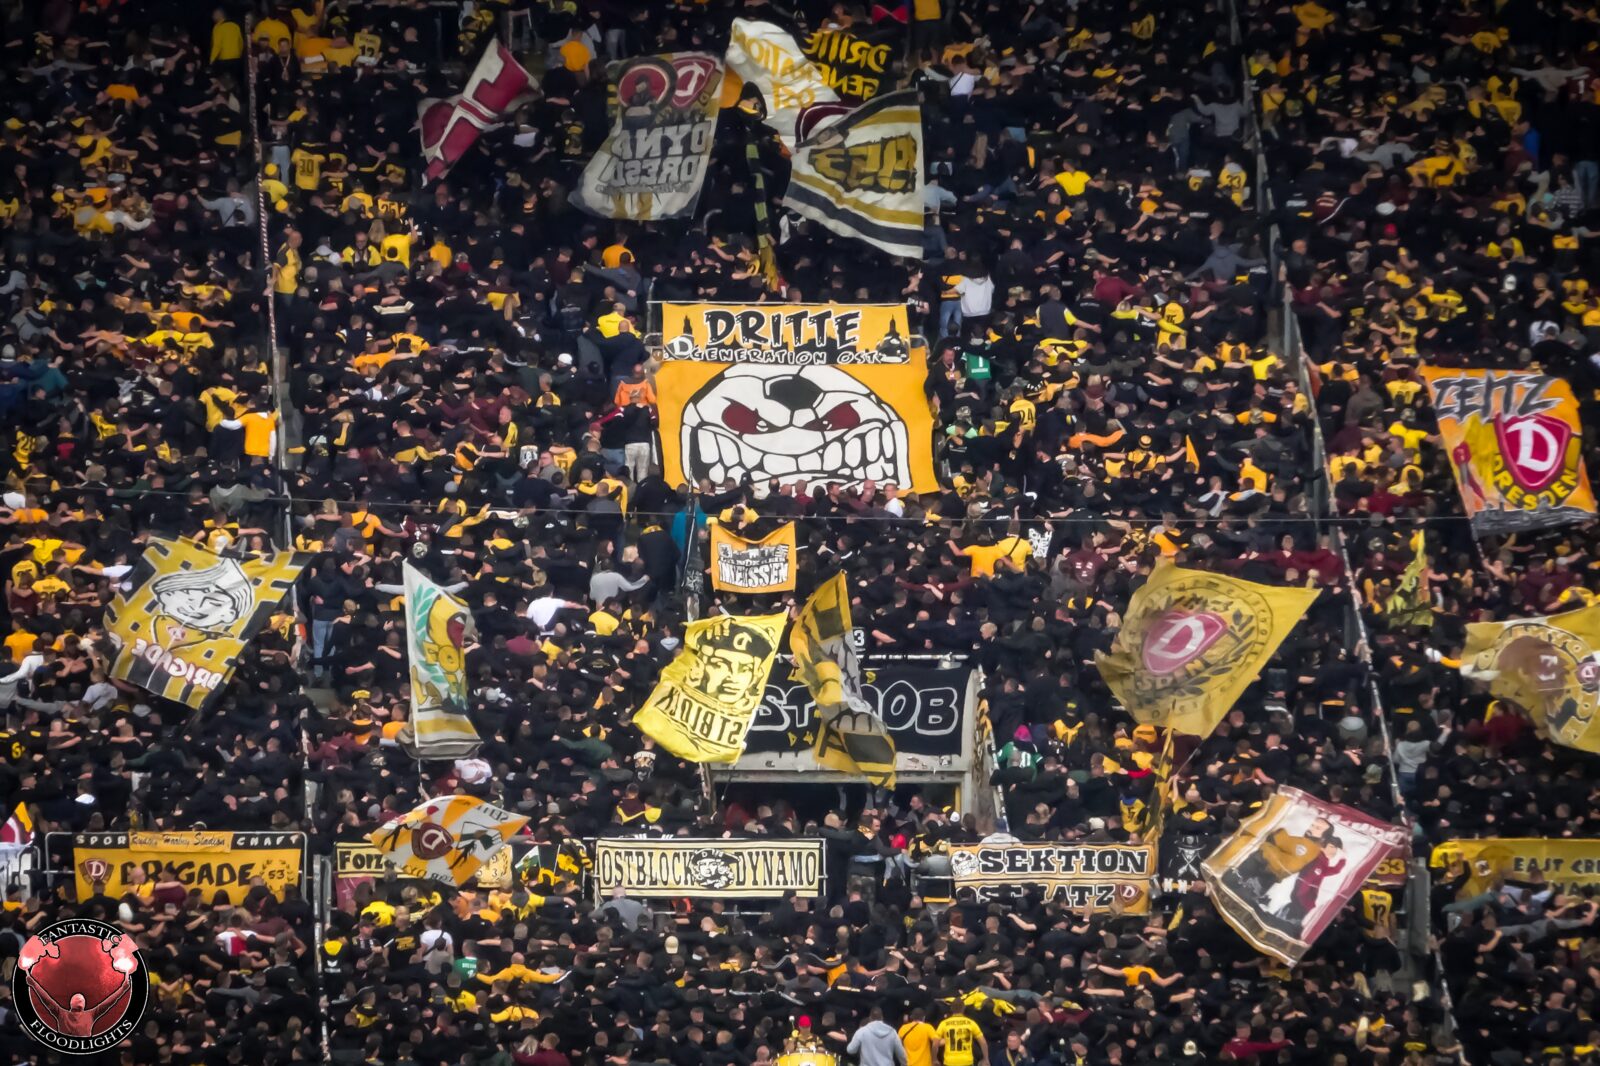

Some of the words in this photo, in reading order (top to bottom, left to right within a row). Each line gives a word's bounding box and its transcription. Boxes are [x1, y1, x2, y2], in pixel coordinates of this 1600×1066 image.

[704, 309, 861, 348] DRITTE
[690, 350, 827, 366] GENERATION
[1431, 372, 1565, 425] ZEITZ
[1506, 419, 1559, 472] D
[1493, 453, 1578, 511] DRESDEN
[718, 560, 789, 588] MEISSEN
[268, 869, 285, 880] 53
[601, 849, 696, 887] OSTBLOCK
[734, 850, 817, 887] DYNAMO
[978, 848, 1148, 876] SEKTION
[1513, 857, 1564, 872] EAST
